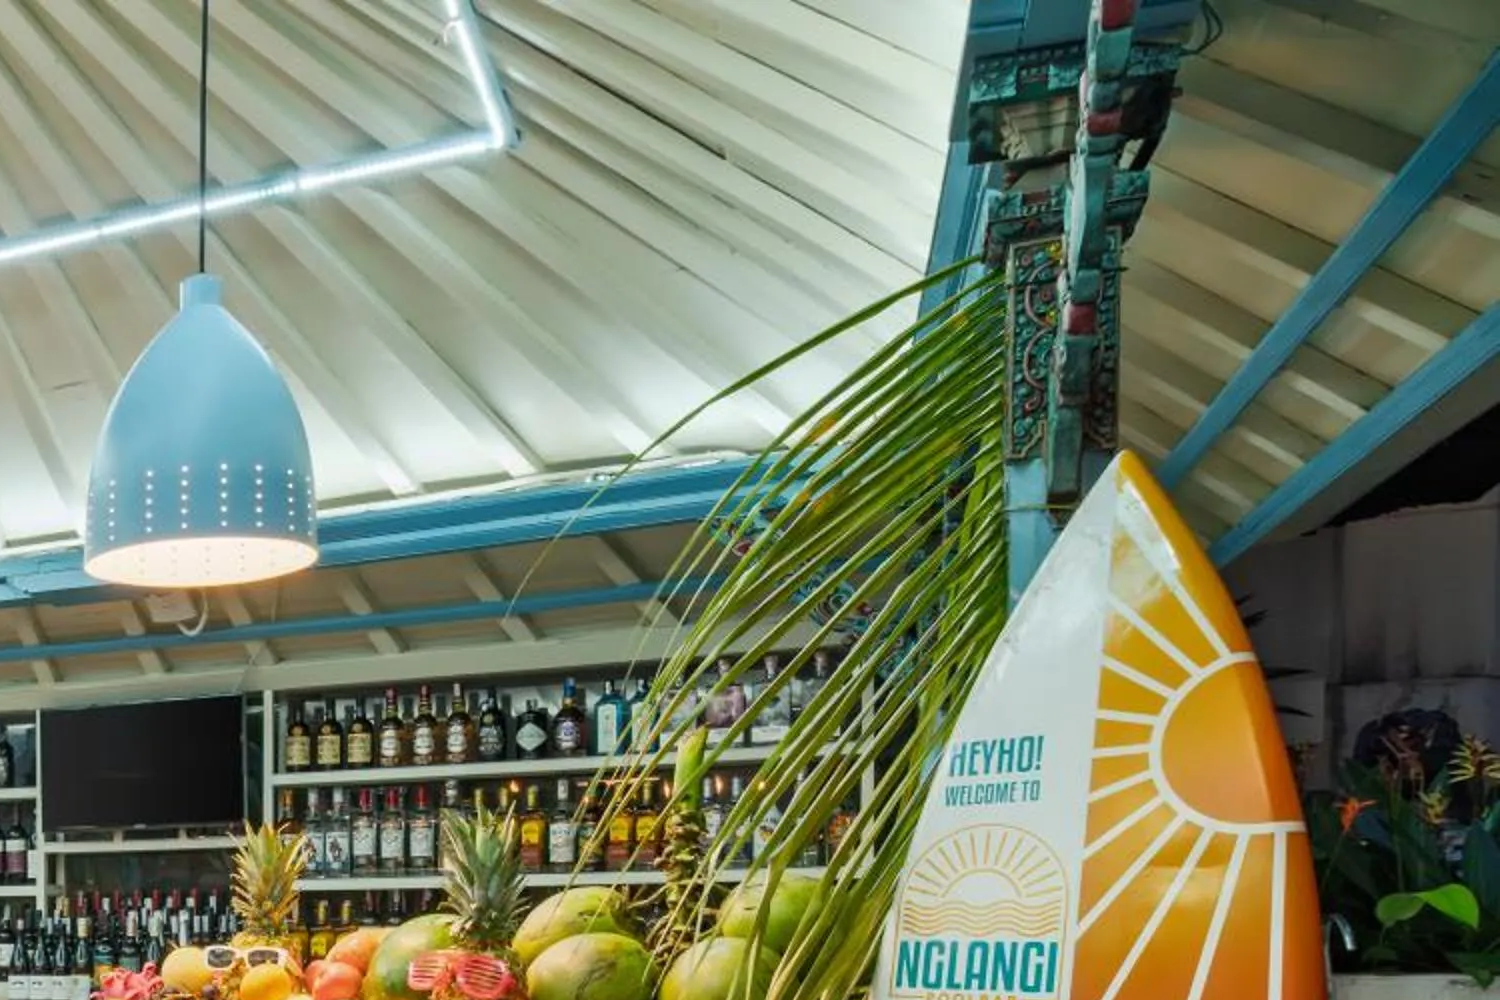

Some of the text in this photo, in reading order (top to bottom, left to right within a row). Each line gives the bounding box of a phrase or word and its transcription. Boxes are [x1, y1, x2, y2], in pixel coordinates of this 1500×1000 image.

[950, 735, 1044, 777] HEYHO!
[945, 779, 1041, 807] WELCOME TO
[896, 939, 1059, 993] NGLANGI
